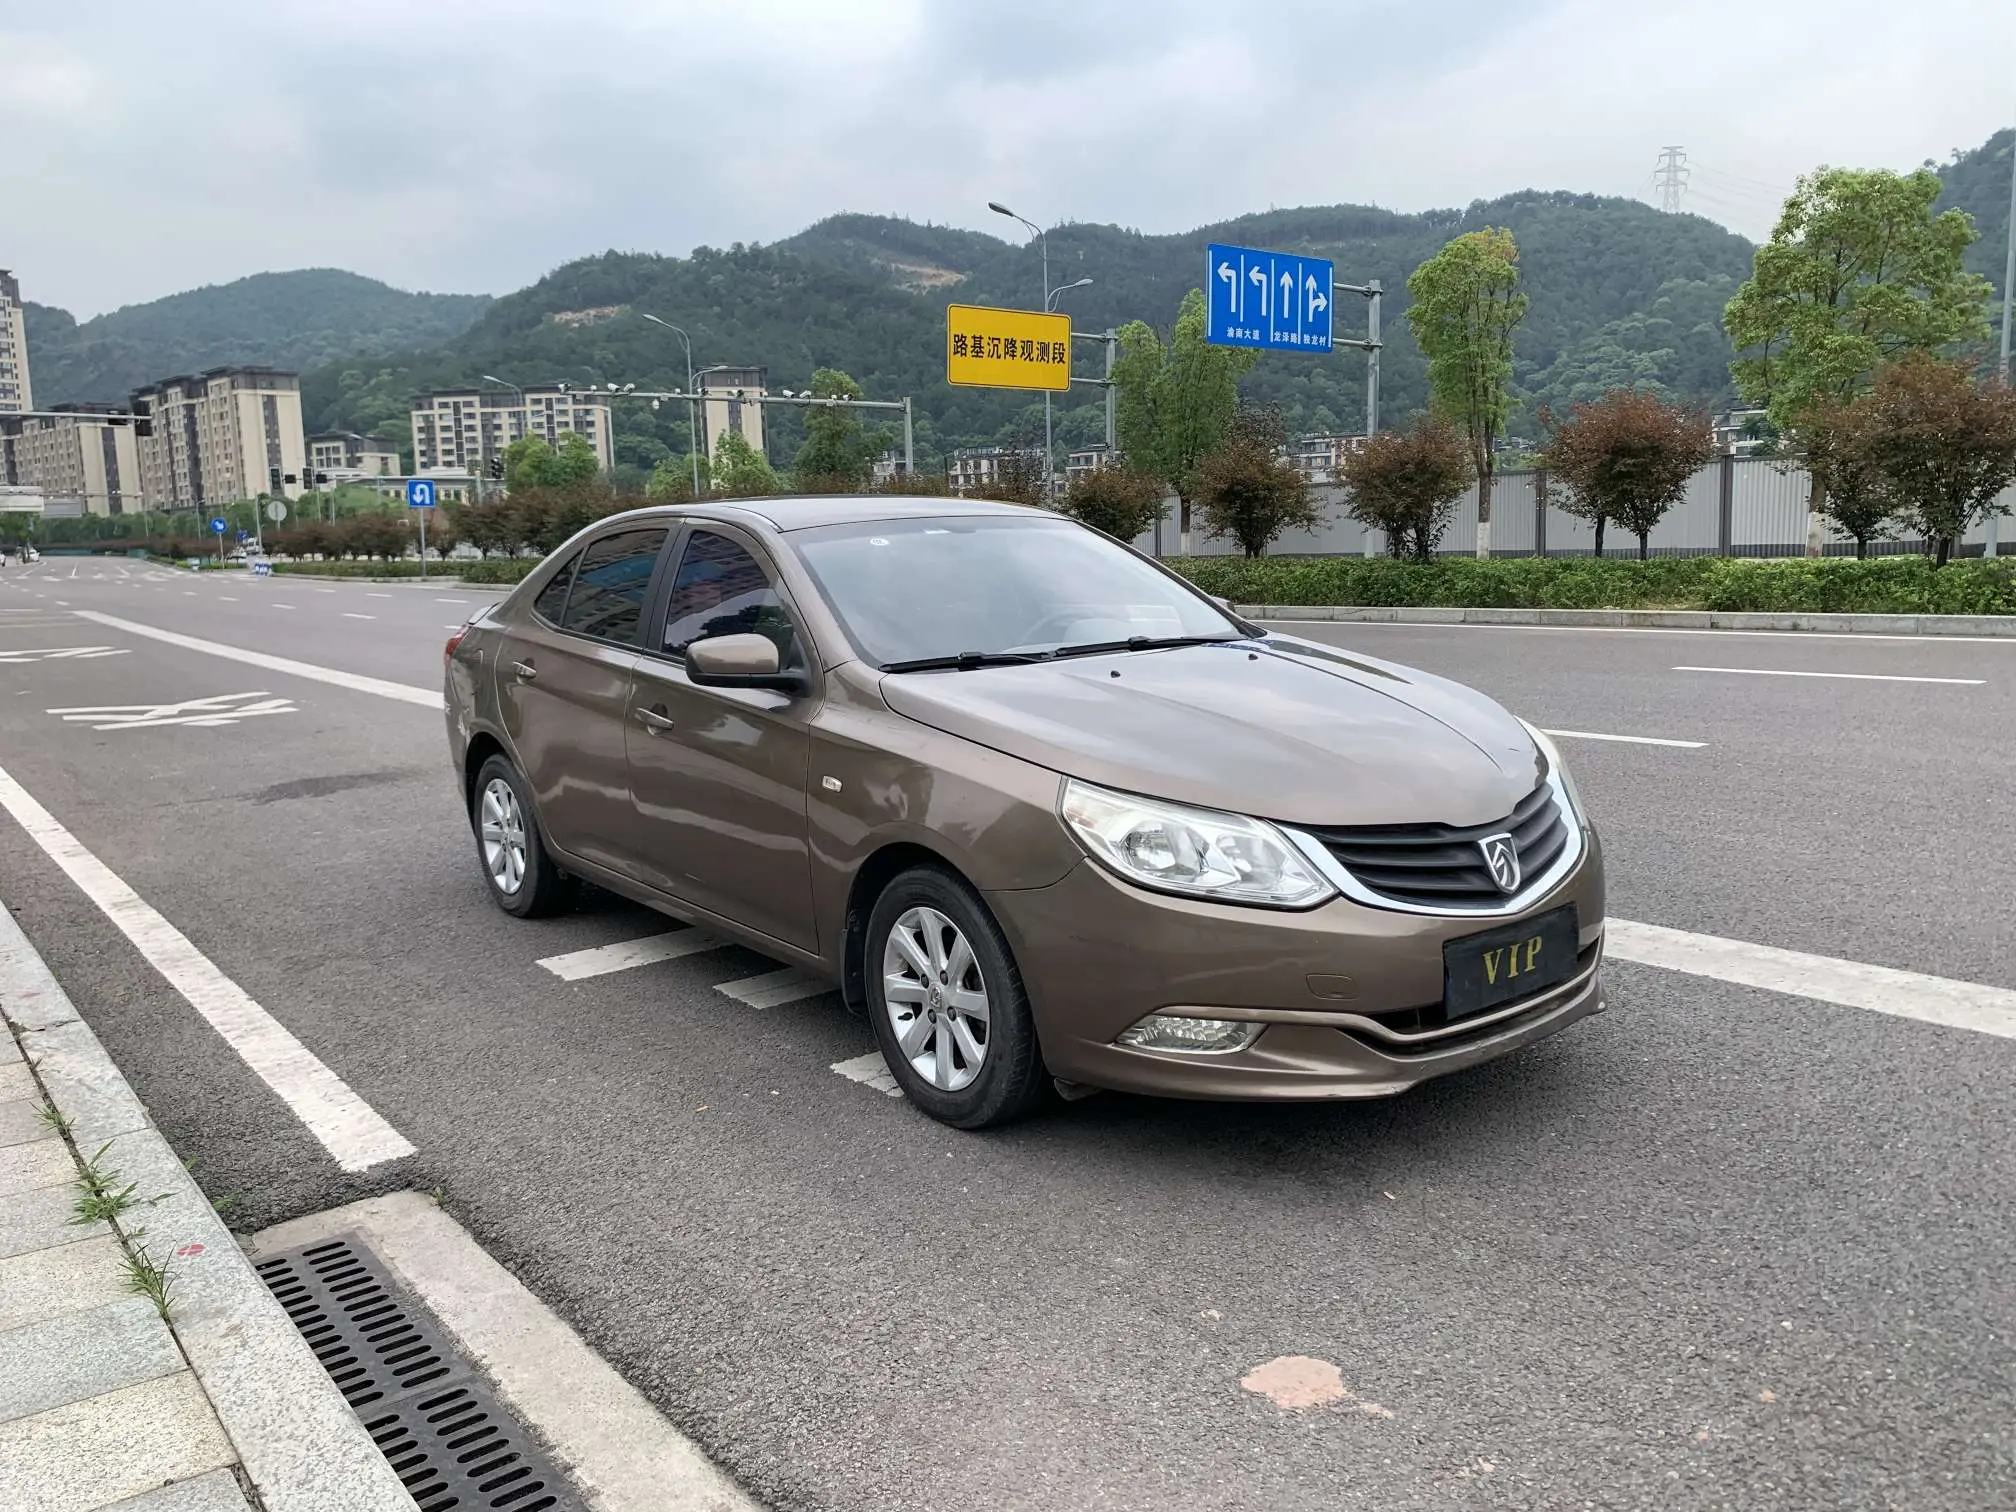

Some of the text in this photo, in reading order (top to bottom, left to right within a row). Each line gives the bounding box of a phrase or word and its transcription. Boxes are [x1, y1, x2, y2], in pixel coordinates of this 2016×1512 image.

[953, 333, 1066, 364] 路基沉降观测段
[1483, 935, 1543, 985] VIP
